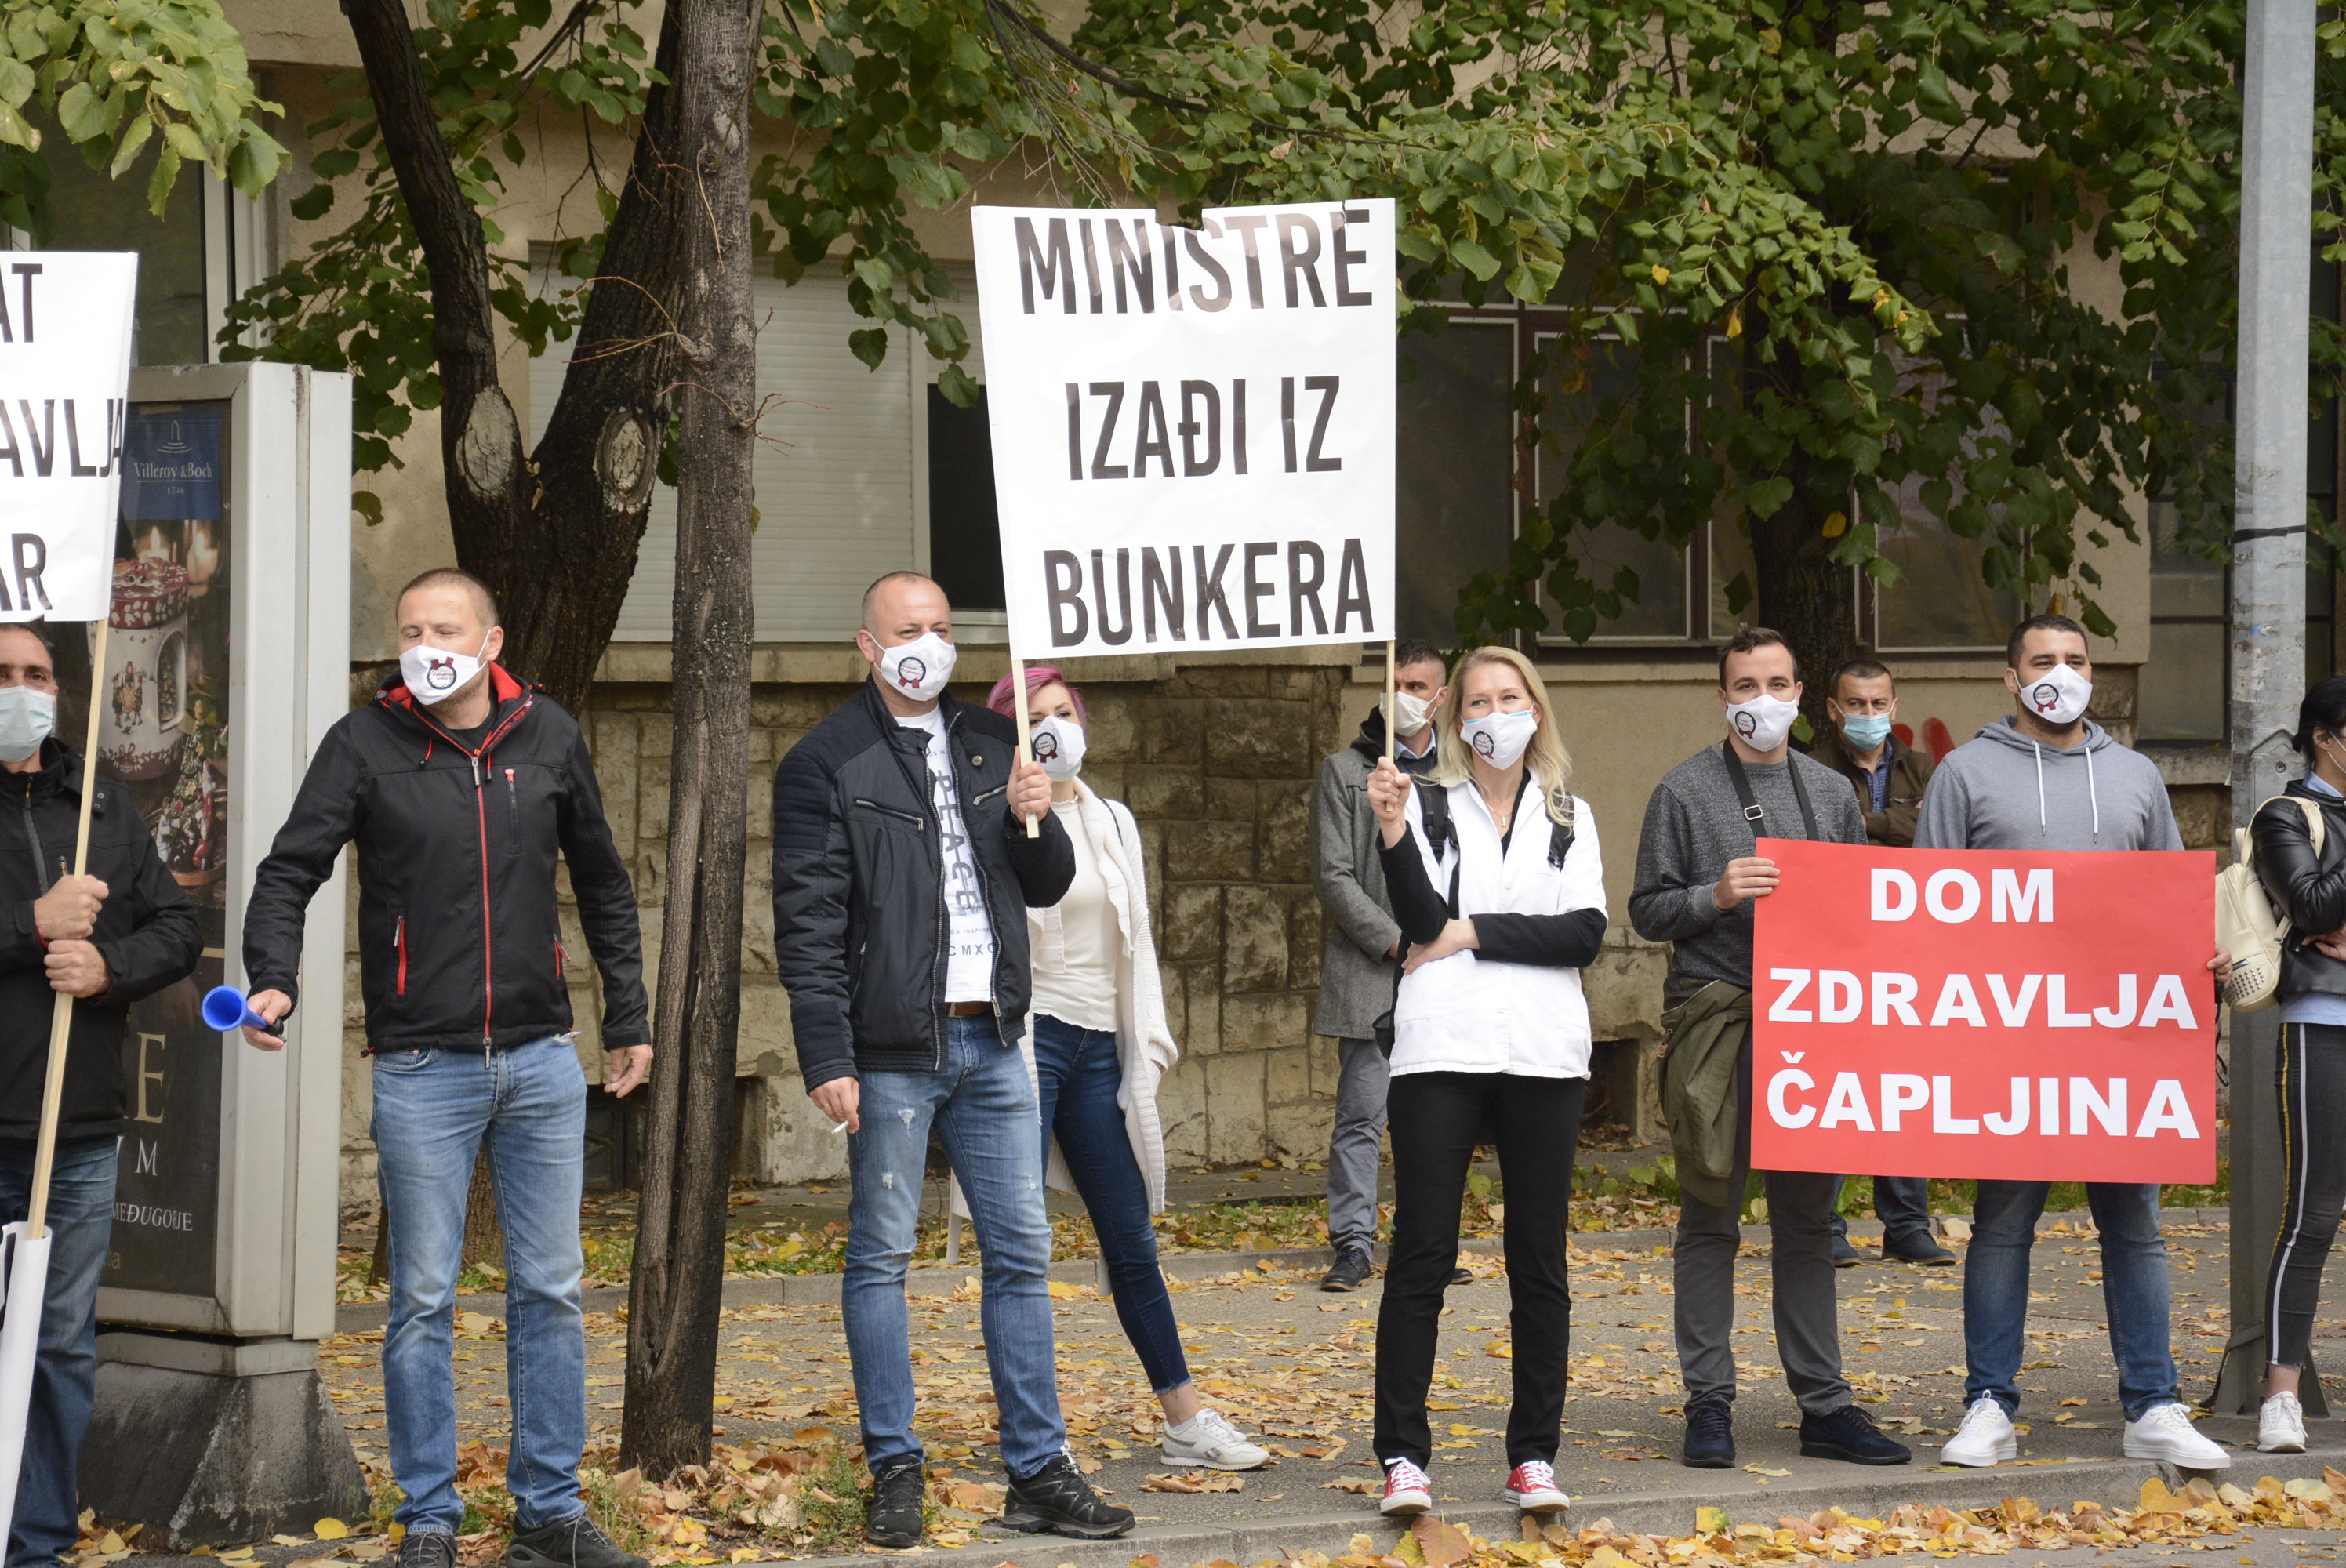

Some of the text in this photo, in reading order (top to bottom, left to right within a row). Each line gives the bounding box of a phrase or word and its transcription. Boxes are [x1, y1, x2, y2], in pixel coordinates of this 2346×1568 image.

[1014, 209, 1372, 314] MINISTRE
[134, 463, 177, 481] Villeroy
[1065, 376, 1342, 481] IZAĐI IZ
[1044, 538, 1374, 648] BUNKERA
[936, 771, 979, 908] PEACE
[1870, 867, 2054, 924] DOM
[1768, 967, 2198, 1029] ZDRAVLJA
[1767, 1051, 2200, 1139] ČAPLJINA
